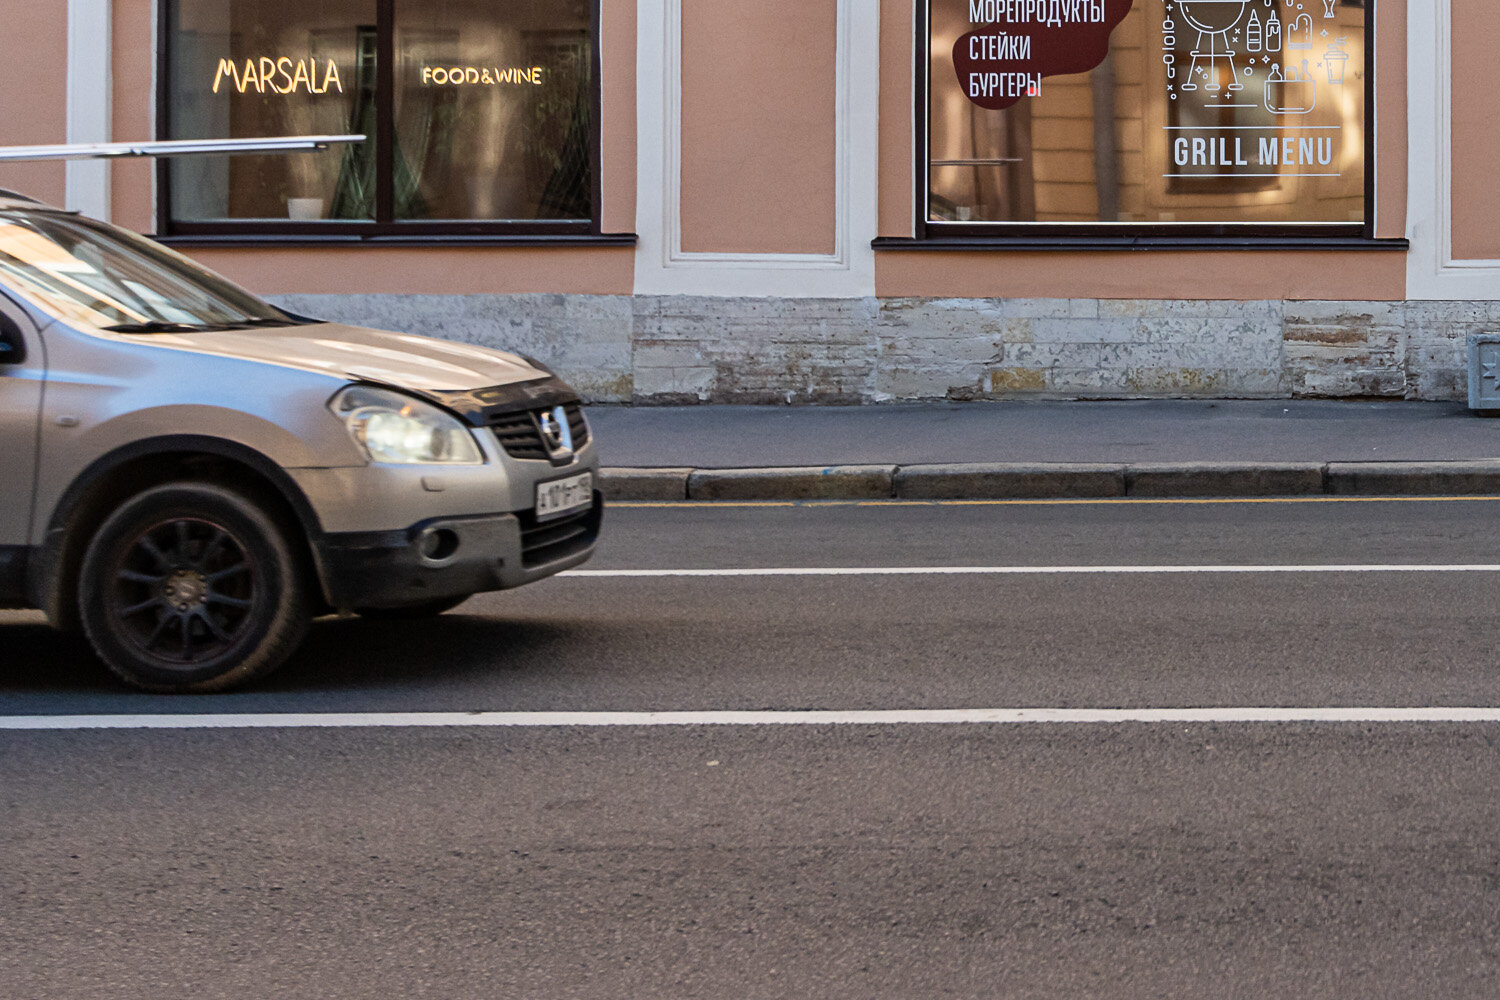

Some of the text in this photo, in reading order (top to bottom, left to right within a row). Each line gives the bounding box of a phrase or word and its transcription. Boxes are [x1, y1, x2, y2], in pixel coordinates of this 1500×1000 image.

[969, 31, 1031, 60] СТЕЙКИ
[212, 56, 343, 94] MARSALA
[969, 72, 1042, 97] БУРГЕРЫ
[1174, 137, 1332, 166] GRILL MENU
